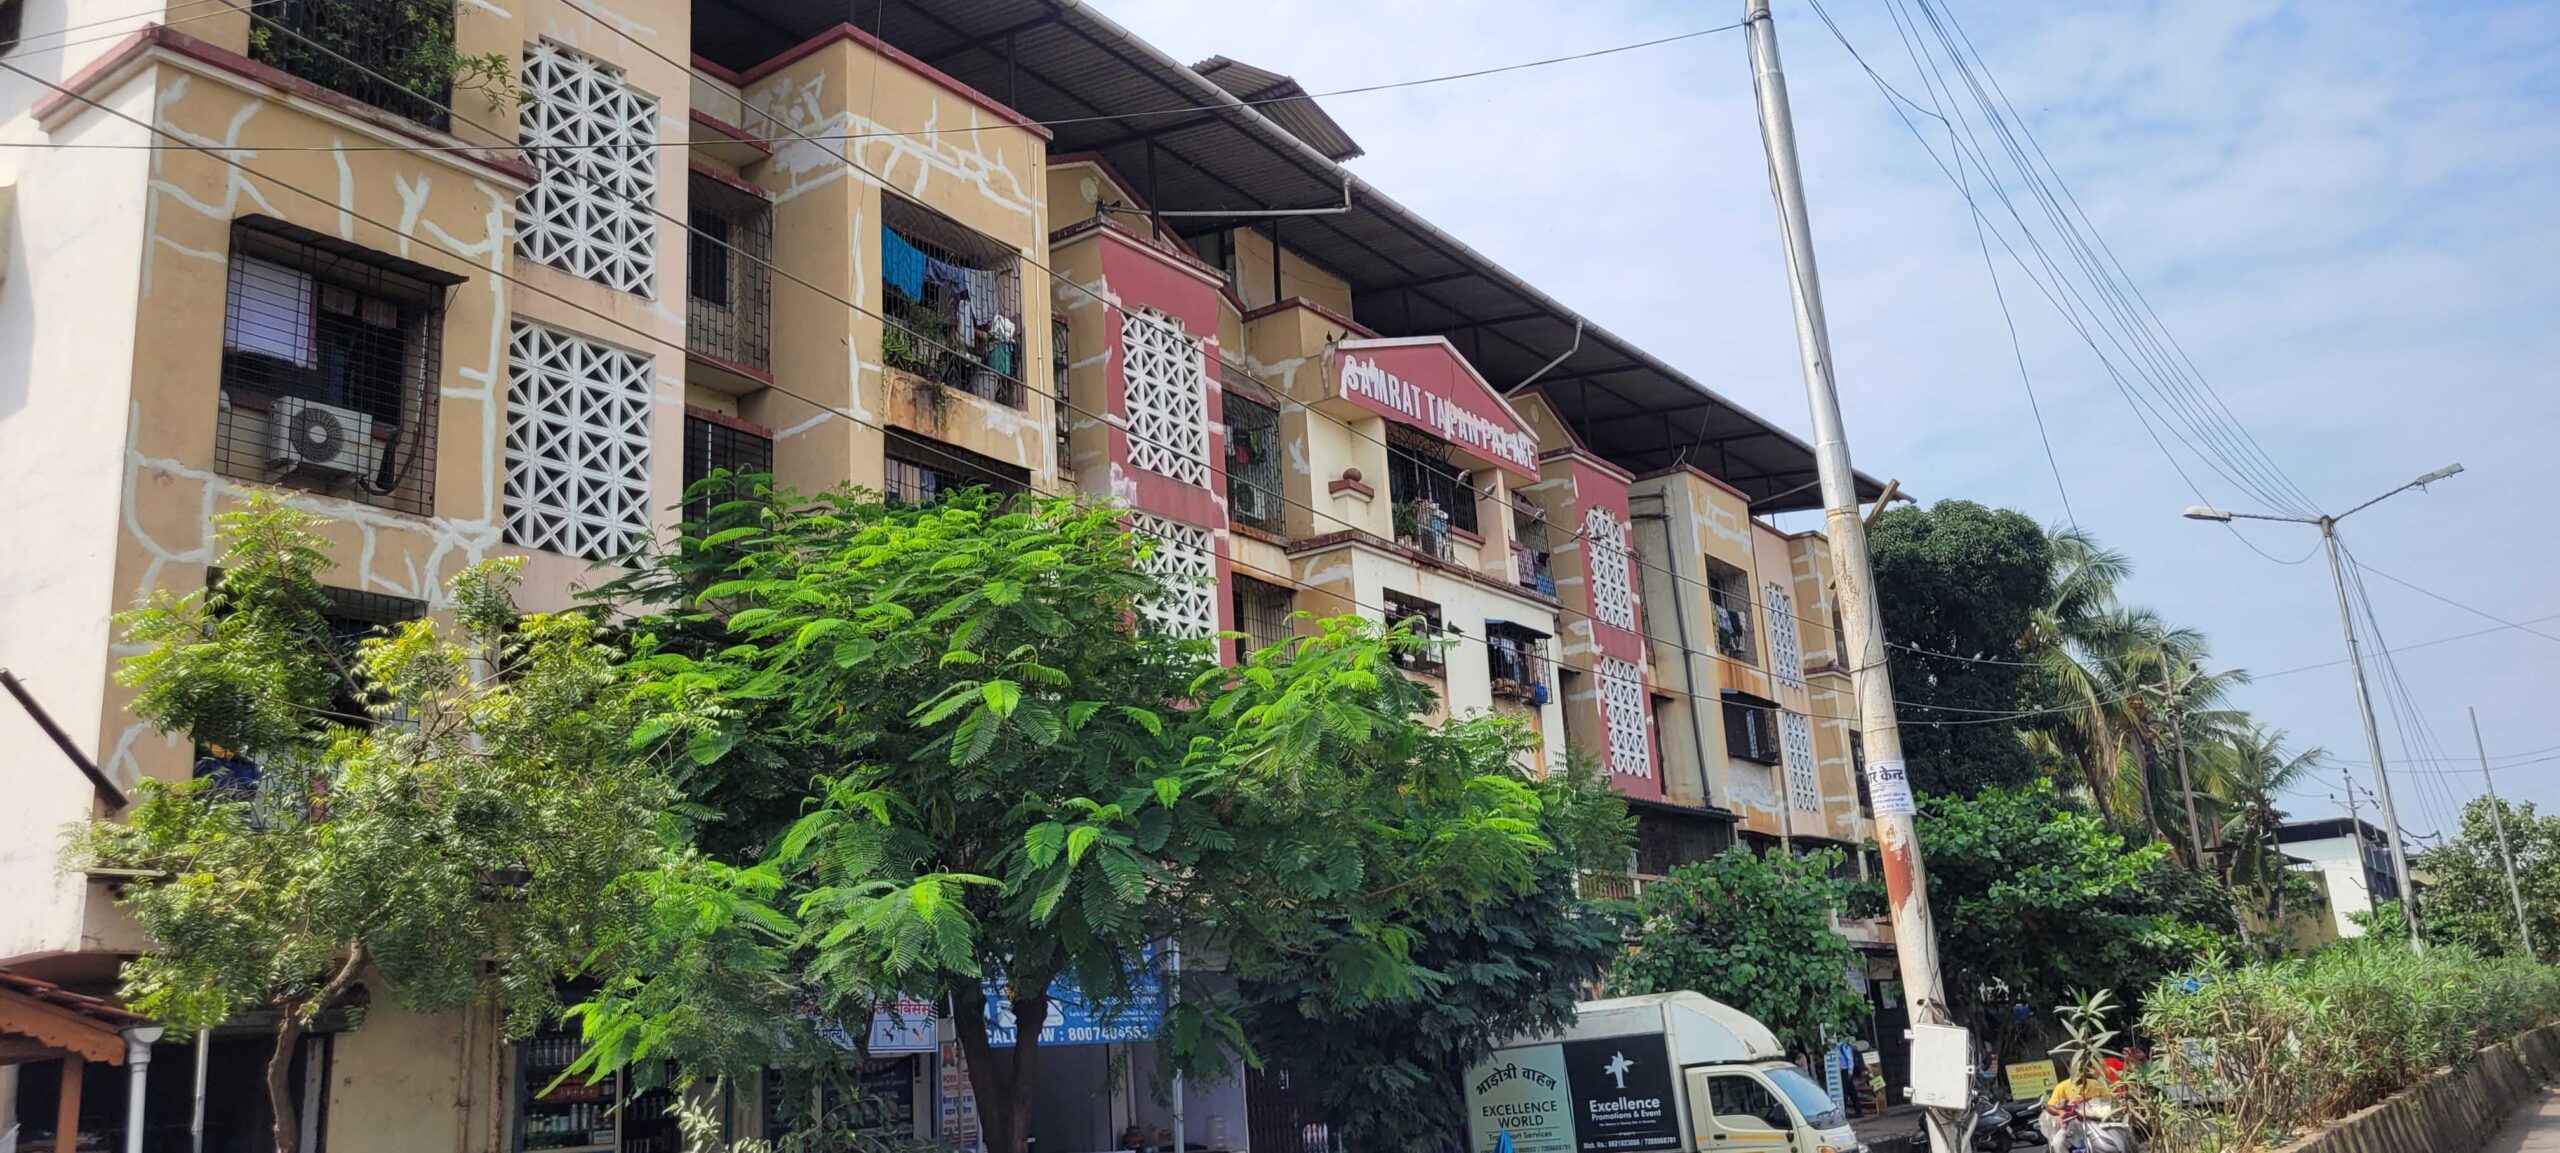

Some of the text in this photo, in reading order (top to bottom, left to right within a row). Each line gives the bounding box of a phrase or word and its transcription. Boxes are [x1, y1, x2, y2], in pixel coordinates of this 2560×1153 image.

[1345, 356, 1421, 421] SAMRAT
[1522, 1067, 1557, 1091] वाहन
[1482, 1101, 1557, 1117] EXCELLENCE
[1589, 1096, 1660, 1113] Excellence
[1498, 1115, 1544, 1128] WORLD
[1591, 1109, 1662, 1121] Promotions & Event
[1523, 1131, 1553, 1139] Services
